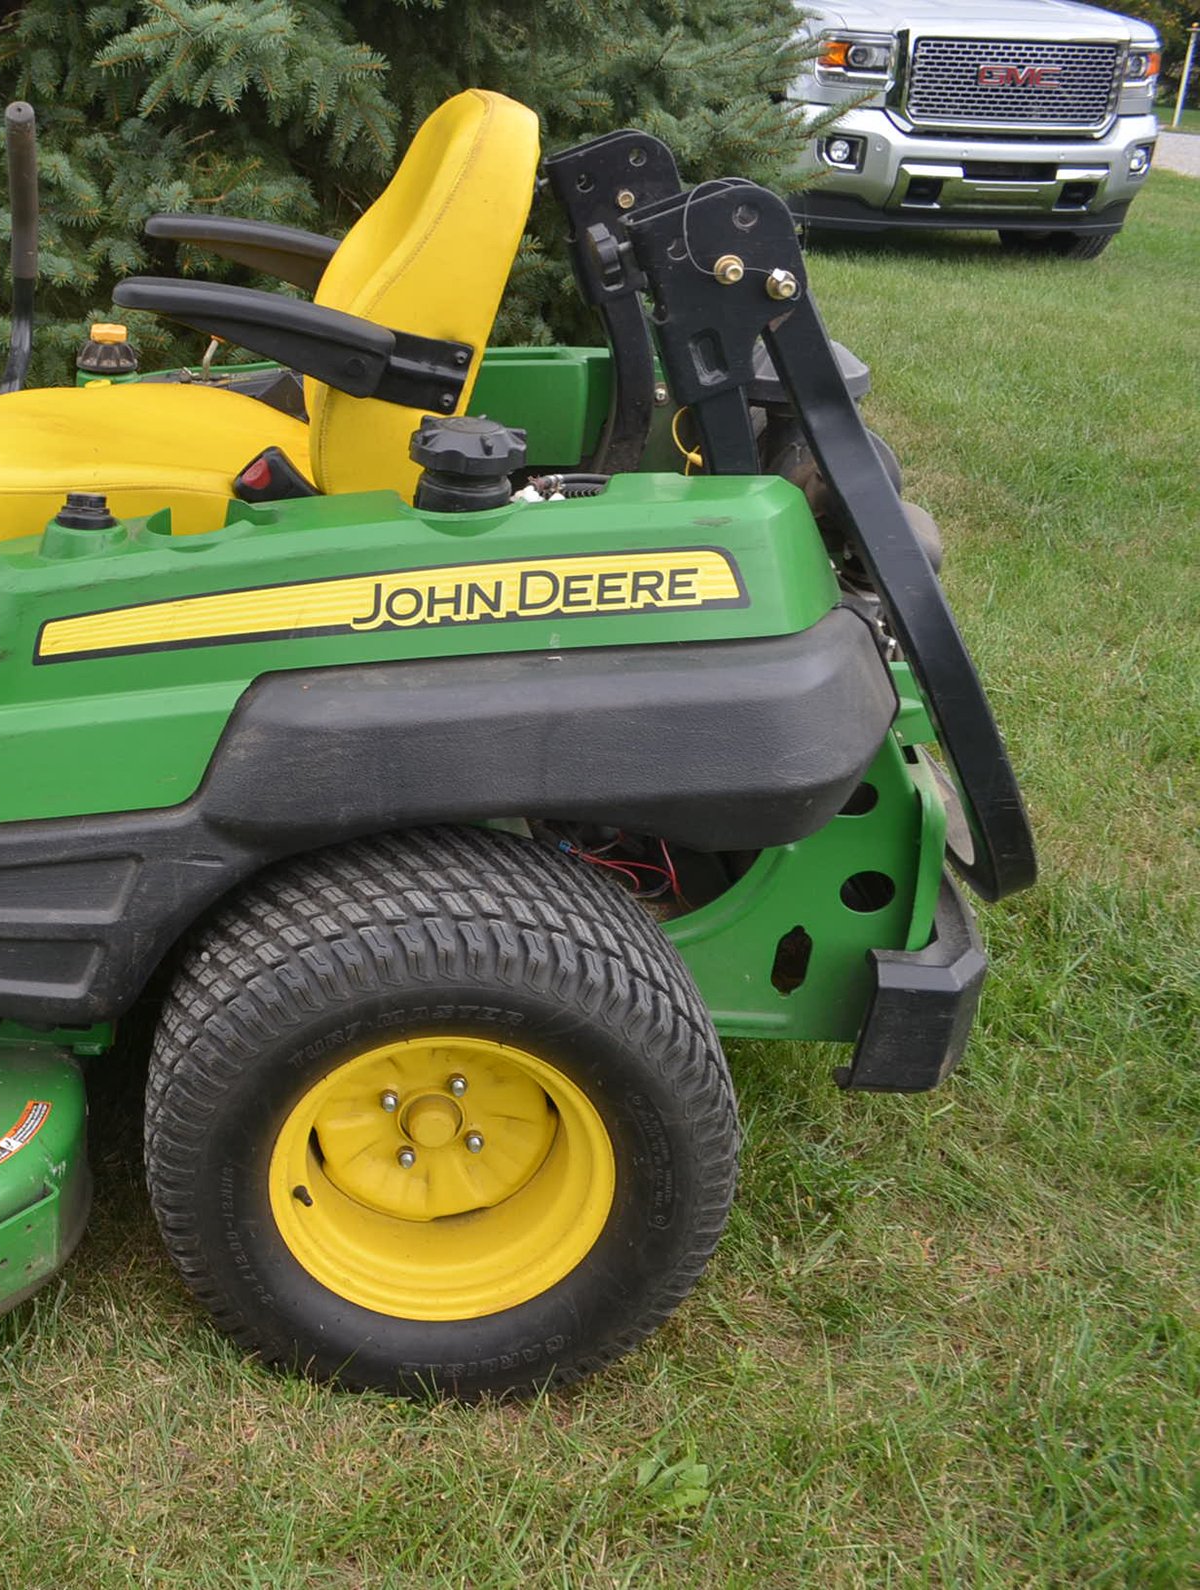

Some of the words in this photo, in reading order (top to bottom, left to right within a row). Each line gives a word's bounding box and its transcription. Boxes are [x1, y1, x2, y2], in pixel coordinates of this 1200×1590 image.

[978, 65, 1062, 88] GMC
[351, 580, 504, 629] JOHN
[517, 567, 701, 614] DEERE
